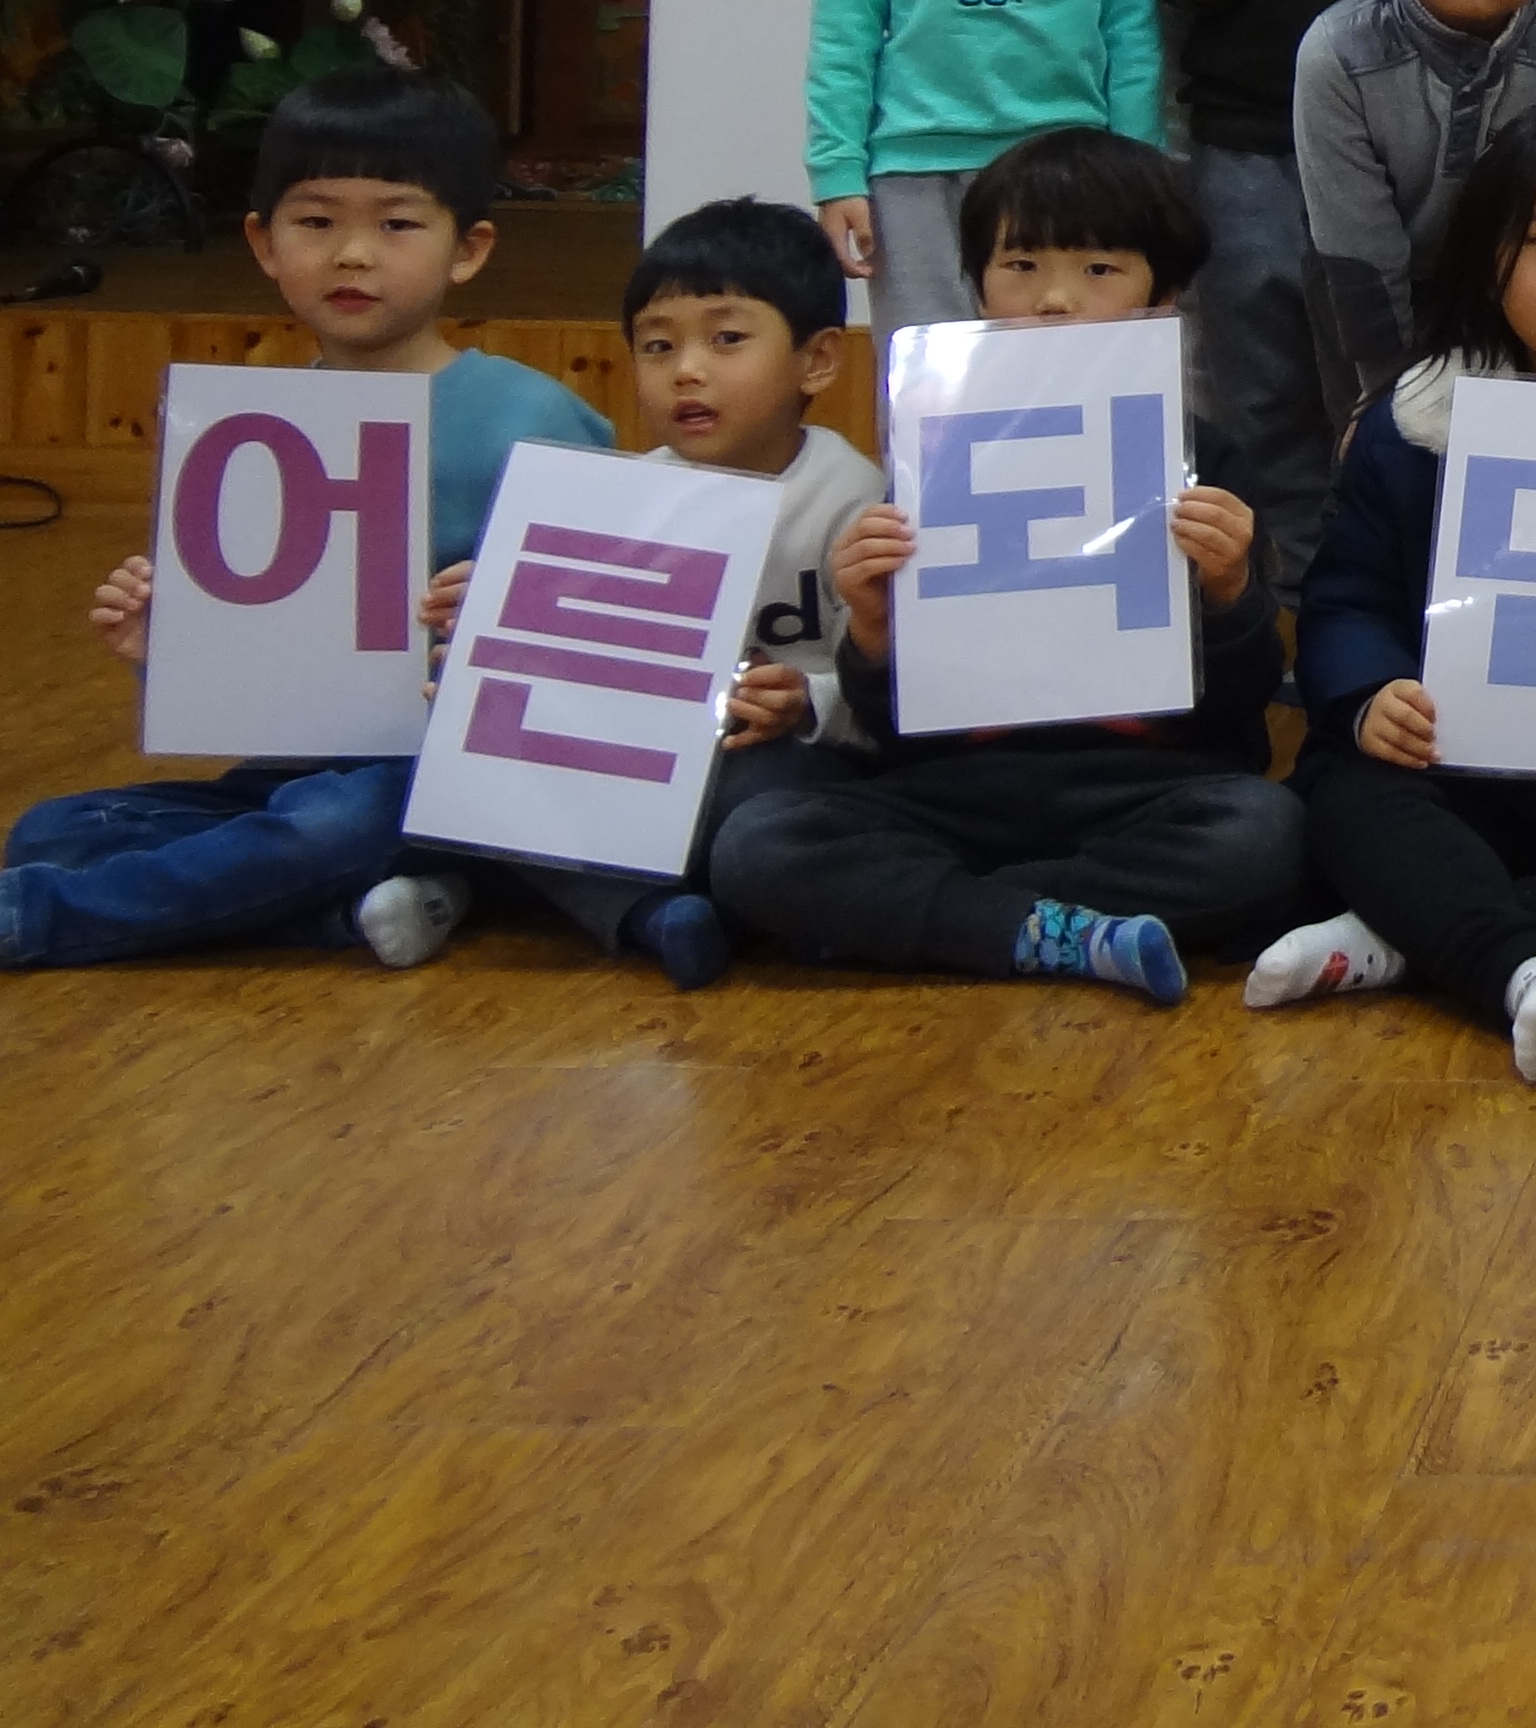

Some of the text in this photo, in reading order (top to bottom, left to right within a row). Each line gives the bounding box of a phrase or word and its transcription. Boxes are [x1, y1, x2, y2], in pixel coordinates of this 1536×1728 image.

[172, 411, 411, 652] 어
[917, 393, 1171, 632] 되
[462, 522, 730, 784] 른
